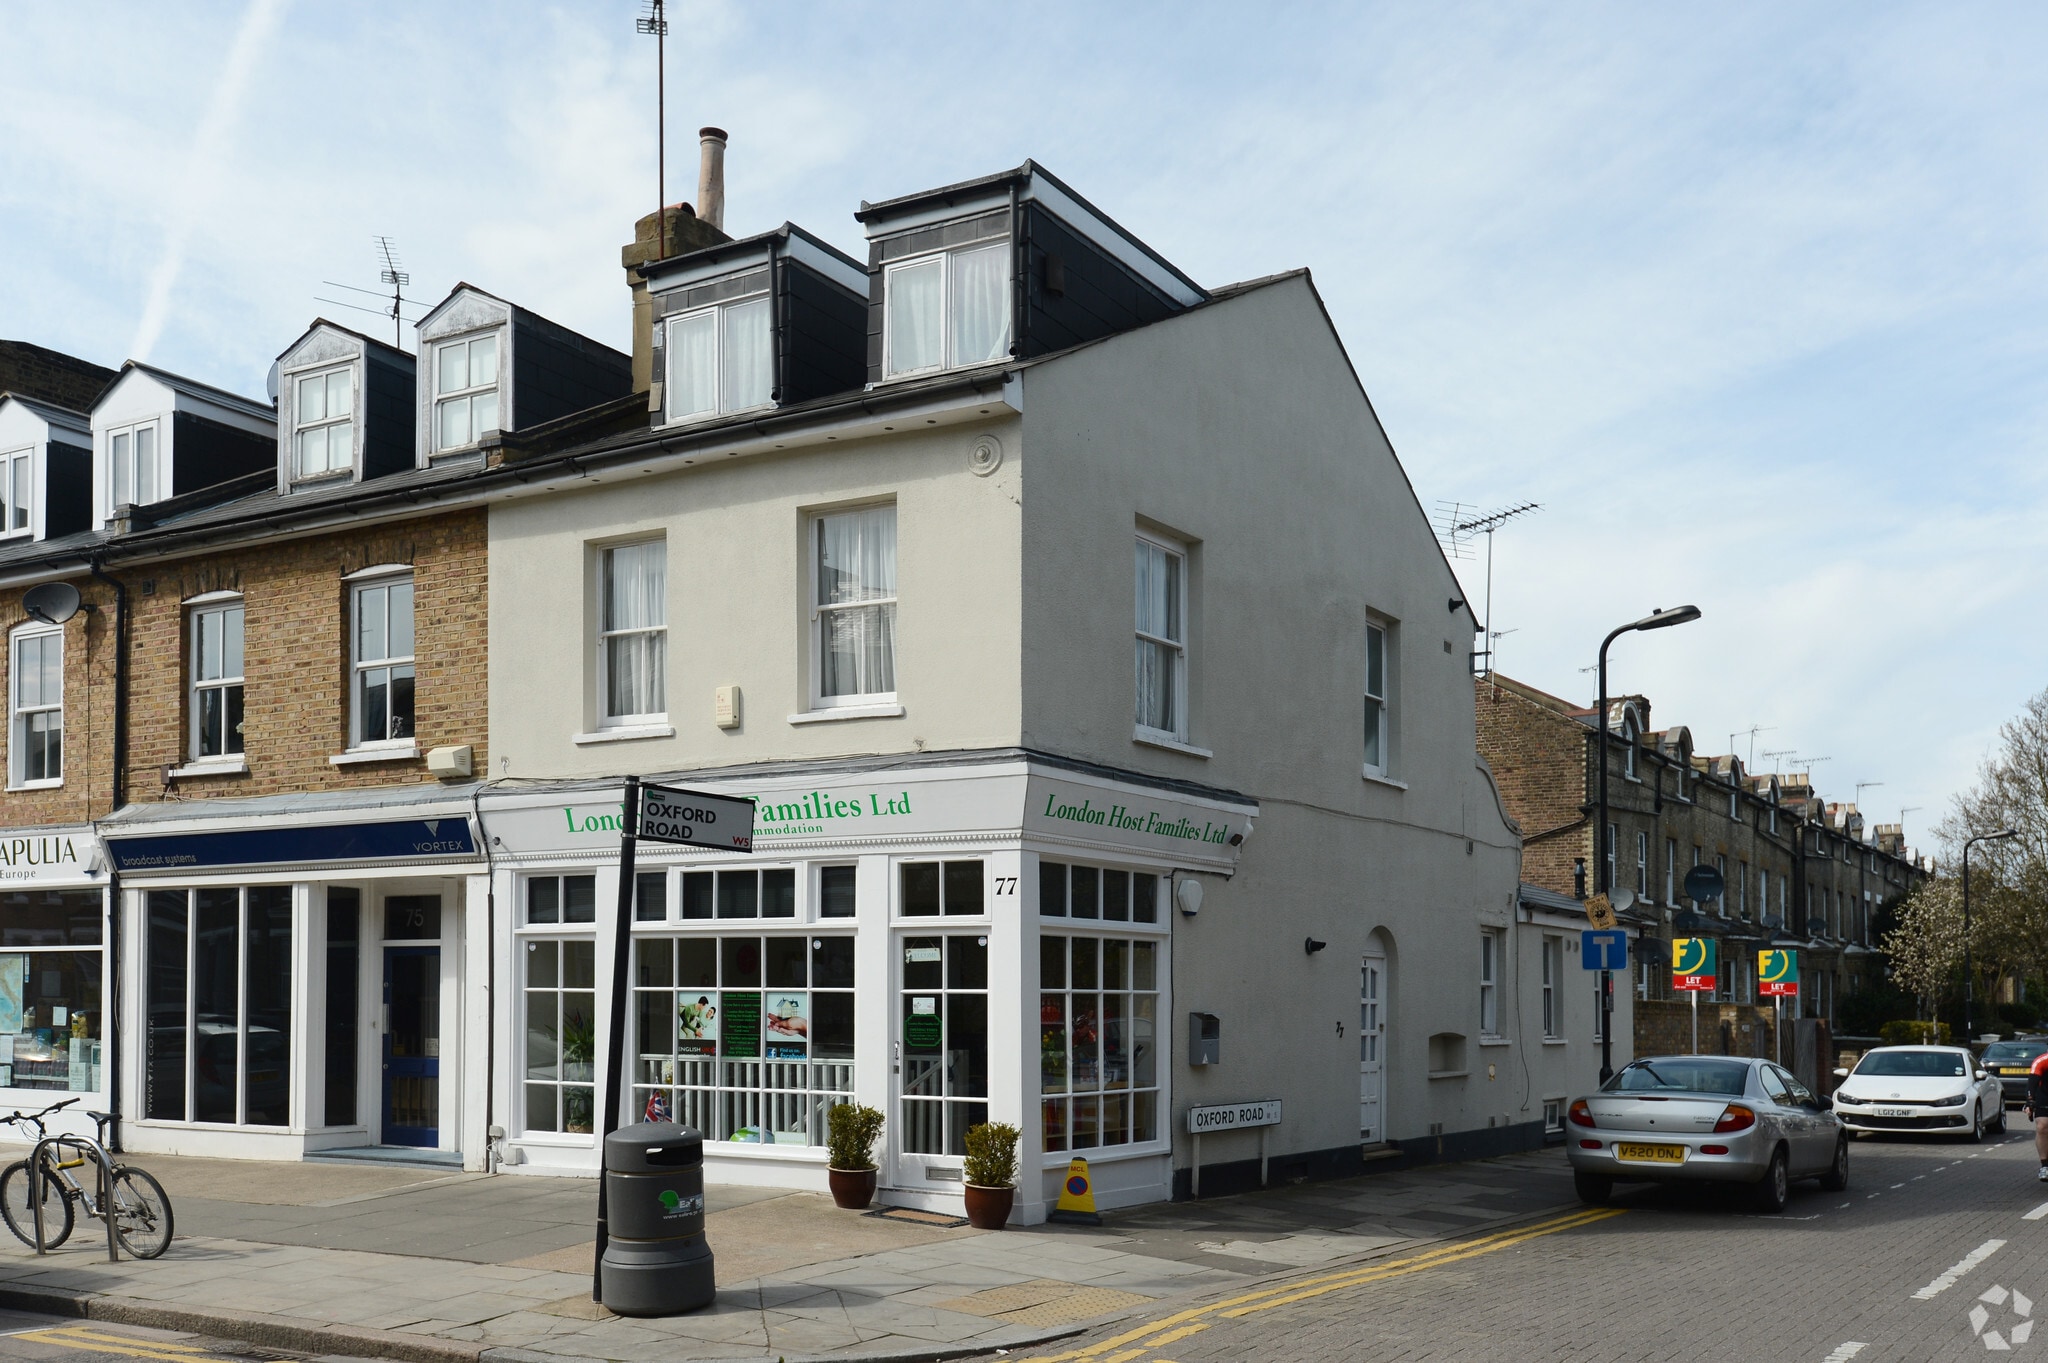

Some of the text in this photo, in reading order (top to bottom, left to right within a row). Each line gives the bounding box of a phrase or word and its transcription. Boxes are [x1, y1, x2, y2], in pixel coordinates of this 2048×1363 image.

[564, 802, 641, 833] Lon
[869, 791, 912, 816] Ltd
[646, 802, 717, 824] OXFORD
[1044, 793, 1228, 844] London Host Families Ltd
[645, 821, 693, 839] ROAD
[412, 840, 463, 852] VORTEX
[732, 836, 750, 847] W5
[121, 854, 197, 867] broadcast systems
[0, 870, 36, 880] Europe
[995, 877, 1018, 895] 77
[405, 908, 424, 927] 75
[1686, 976, 1701, 984] LET
[1196, 1110, 1235, 1127] OXFORD
[1239, 1107, 1264, 1122] ROAD
[1621, 1146, 1683, 1159] V520 DNJ
